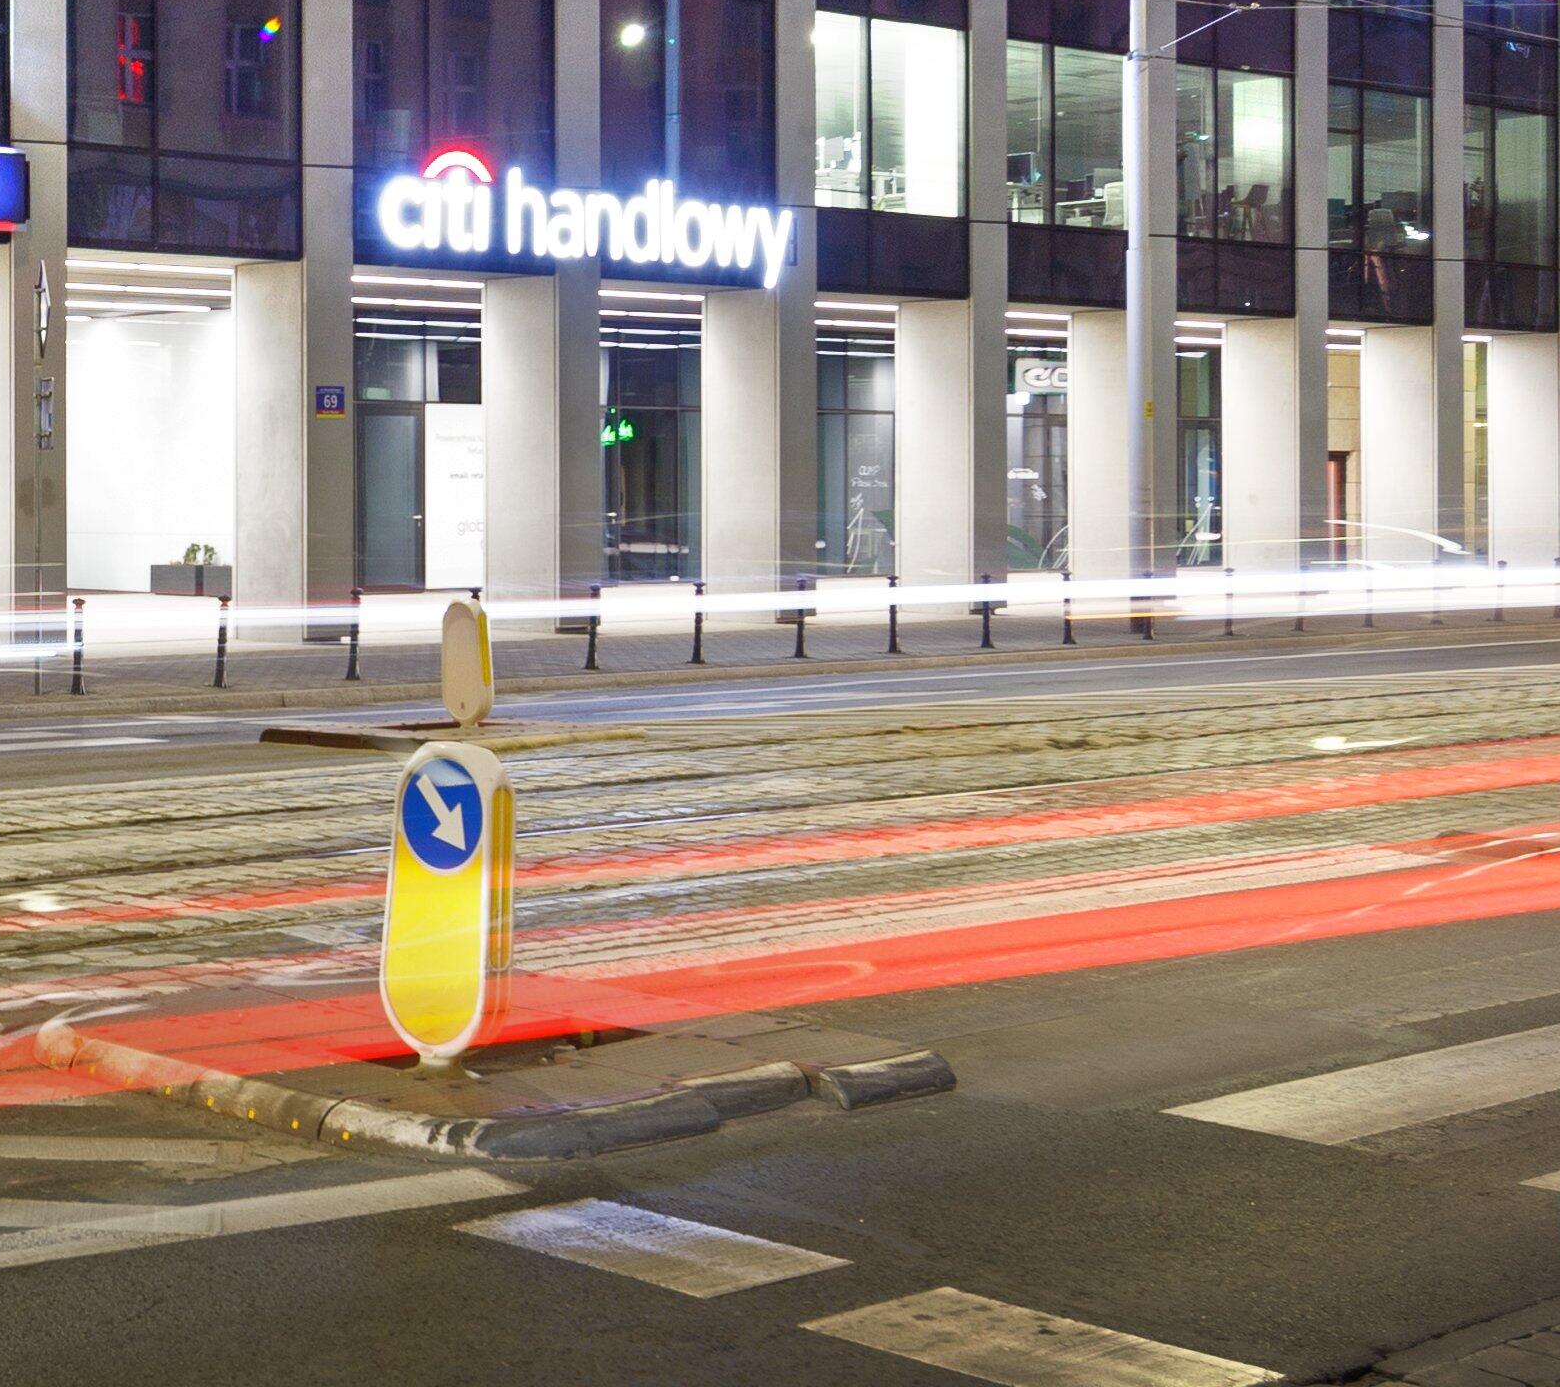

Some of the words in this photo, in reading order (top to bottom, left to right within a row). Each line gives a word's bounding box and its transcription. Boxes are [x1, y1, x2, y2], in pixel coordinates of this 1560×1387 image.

[380, 165, 493, 253] citi
[505, 165, 793, 291] handlowy
[323, 394, 338, 408] 69
